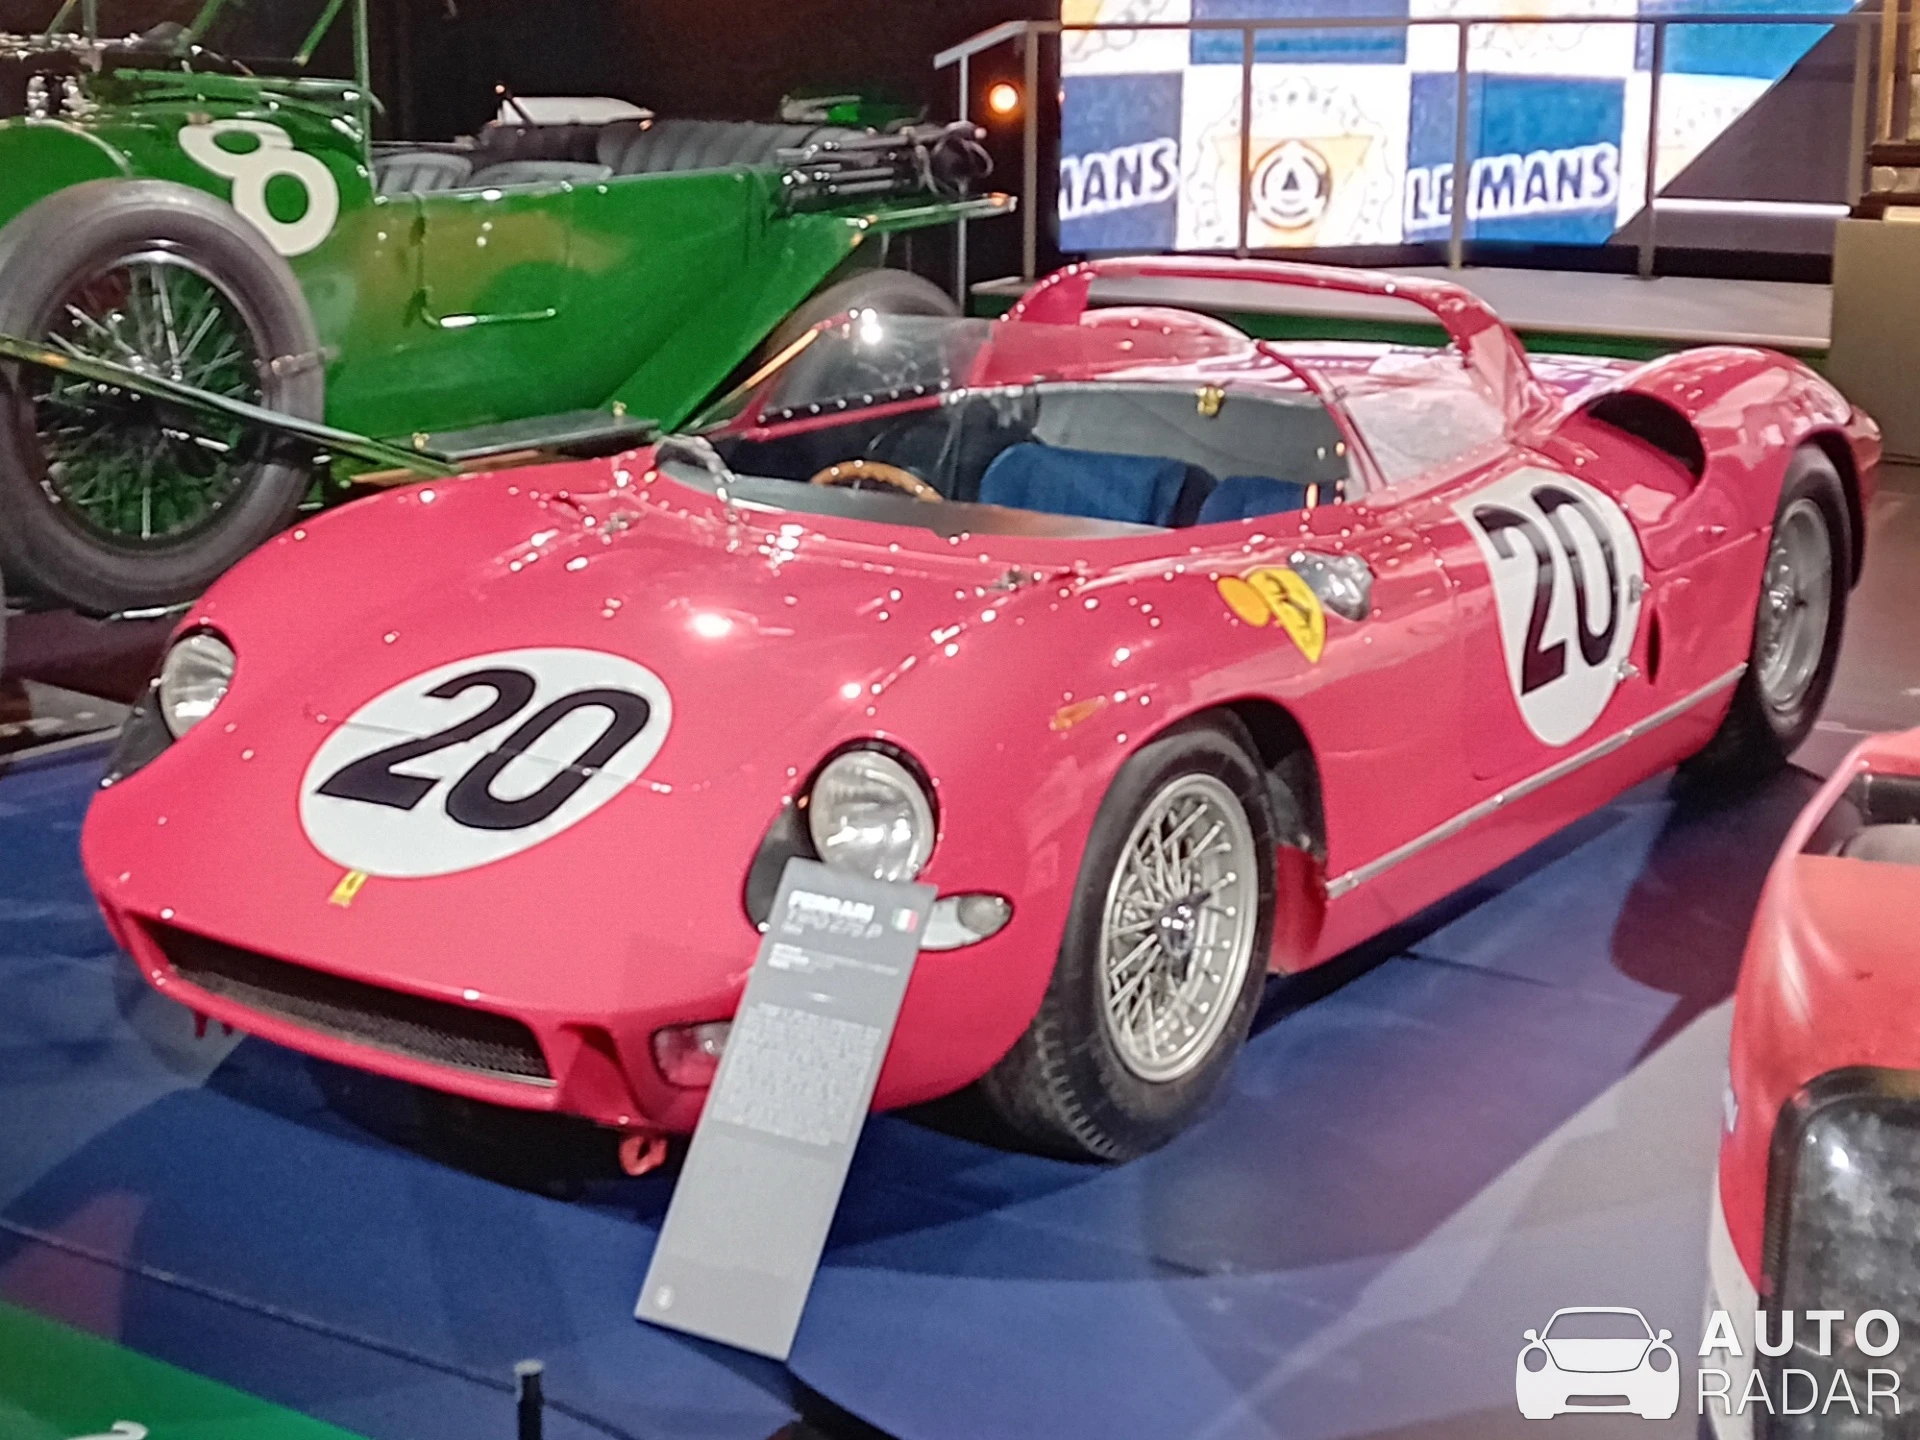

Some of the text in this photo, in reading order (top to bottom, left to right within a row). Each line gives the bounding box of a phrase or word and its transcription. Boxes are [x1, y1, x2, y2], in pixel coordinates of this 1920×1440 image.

[178, 119, 340, 257] 8
[1413, 152, 1609, 220] LE MANS
[1473, 484, 1620, 696] 20
[315, 668, 651, 831] 20
